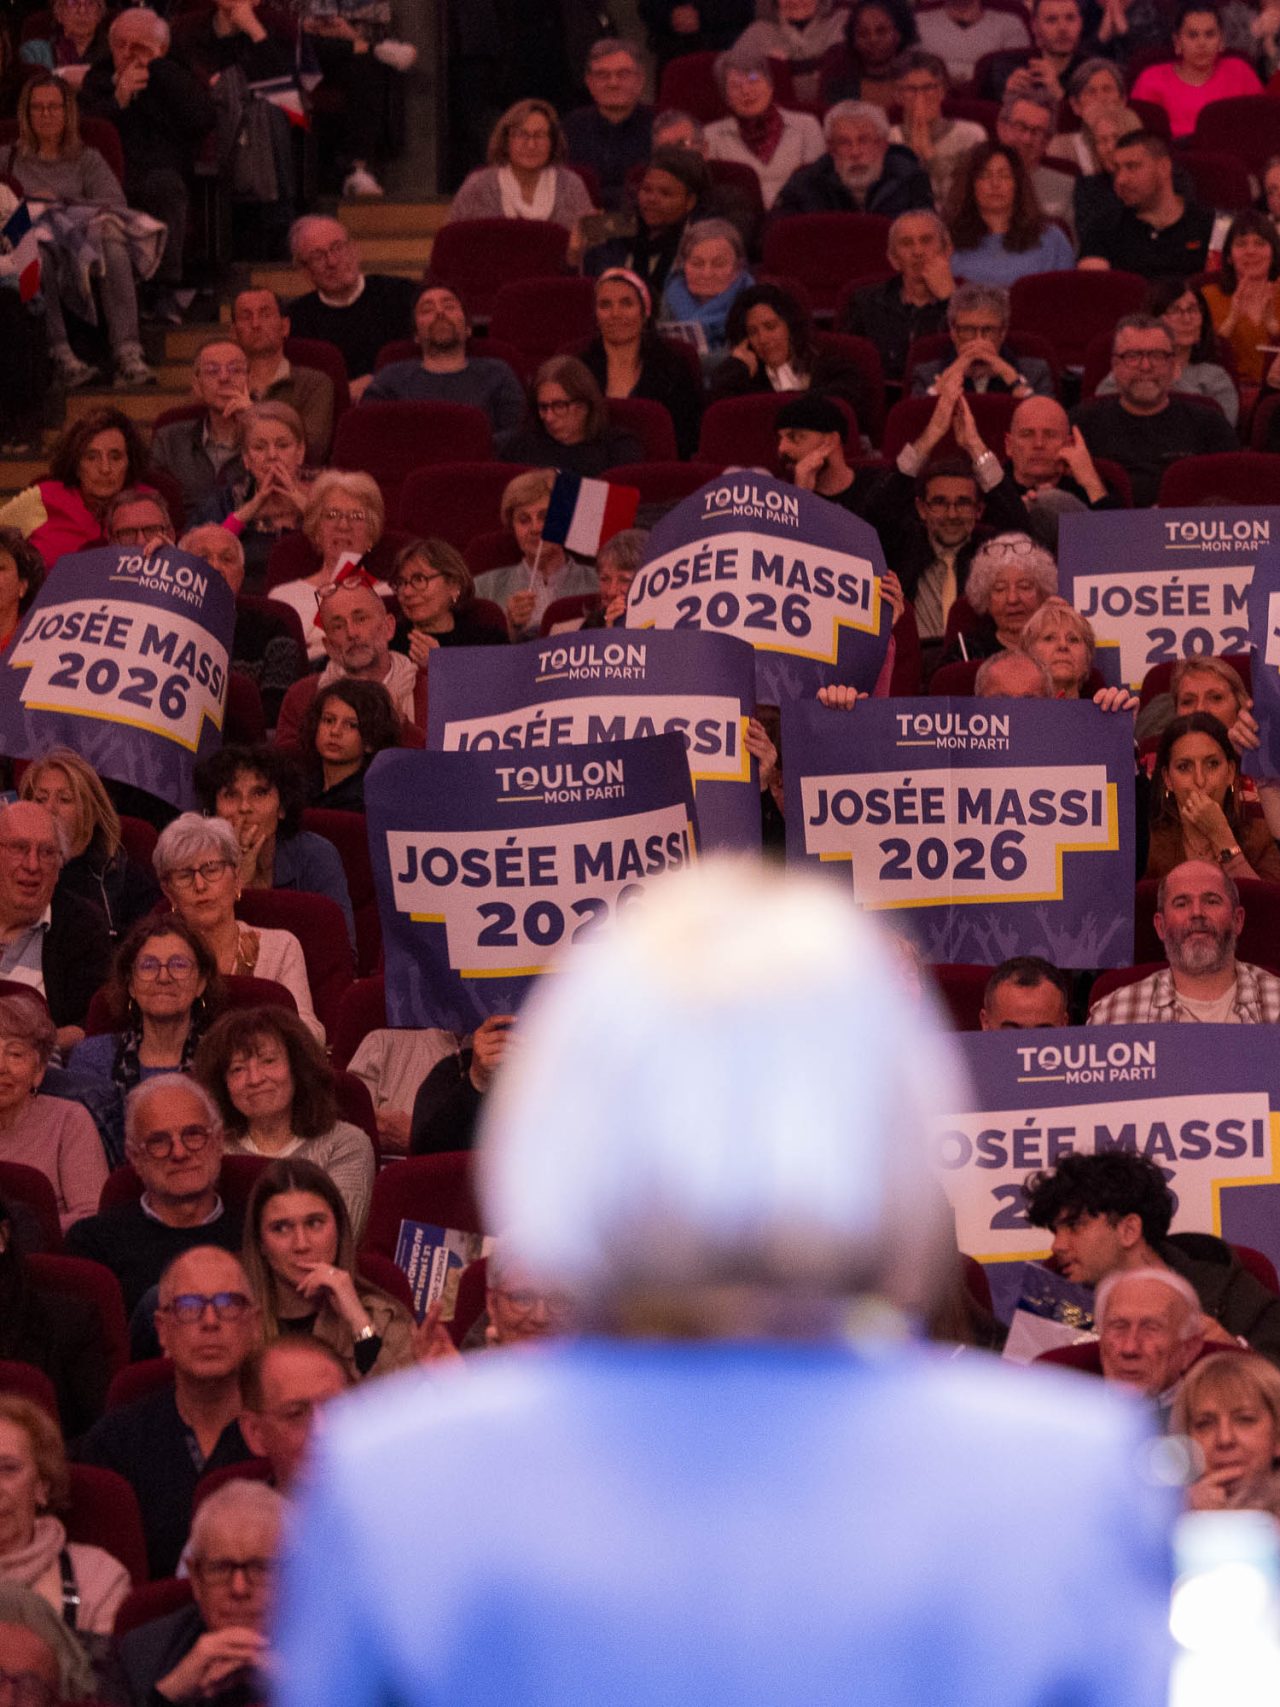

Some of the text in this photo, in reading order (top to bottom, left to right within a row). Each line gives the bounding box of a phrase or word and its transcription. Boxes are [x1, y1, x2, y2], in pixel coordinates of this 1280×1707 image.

[704, 484, 799, 516] TOULON
[732, 505, 799, 528] MON PARTI
[1165, 520, 1270, 541] TOULON
[1201, 540, 1270, 551] MON PAR
[116, 555, 208, 598] TOULON
[138, 575, 204, 609] MON PARTI
[631, 543, 871, 611] JOSÉE MASSI
[1080, 576, 1211, 618] JOSÉE
[673, 591, 812, 638] 2026
[22, 604, 226, 705] JOSÉE MASSI
[538, 644, 647, 673] TOULON
[1145, 626, 1250, 664] 202
[48, 652, 191, 720] 2026
[568, 667, 646, 680] MON PARTI
[587, 715, 738, 758] MASSI
[896, 713, 1010, 737] TOULON
[936, 736, 1010, 751] MON PARTI
[495, 759, 625, 792] TOULON
[543, 785, 625, 804] MON PARTI
[809, 777, 1103, 828] JOSÉE MASSI
[398, 829, 693, 888] JOSÉE MASSI
[879, 829, 1028, 882] 2026
[1017, 1040, 1157, 1072] TOULON
[1065, 1066, 1157, 1085] MON PARTI
[938, 1117, 1265, 1171] OSÉE MASSI
